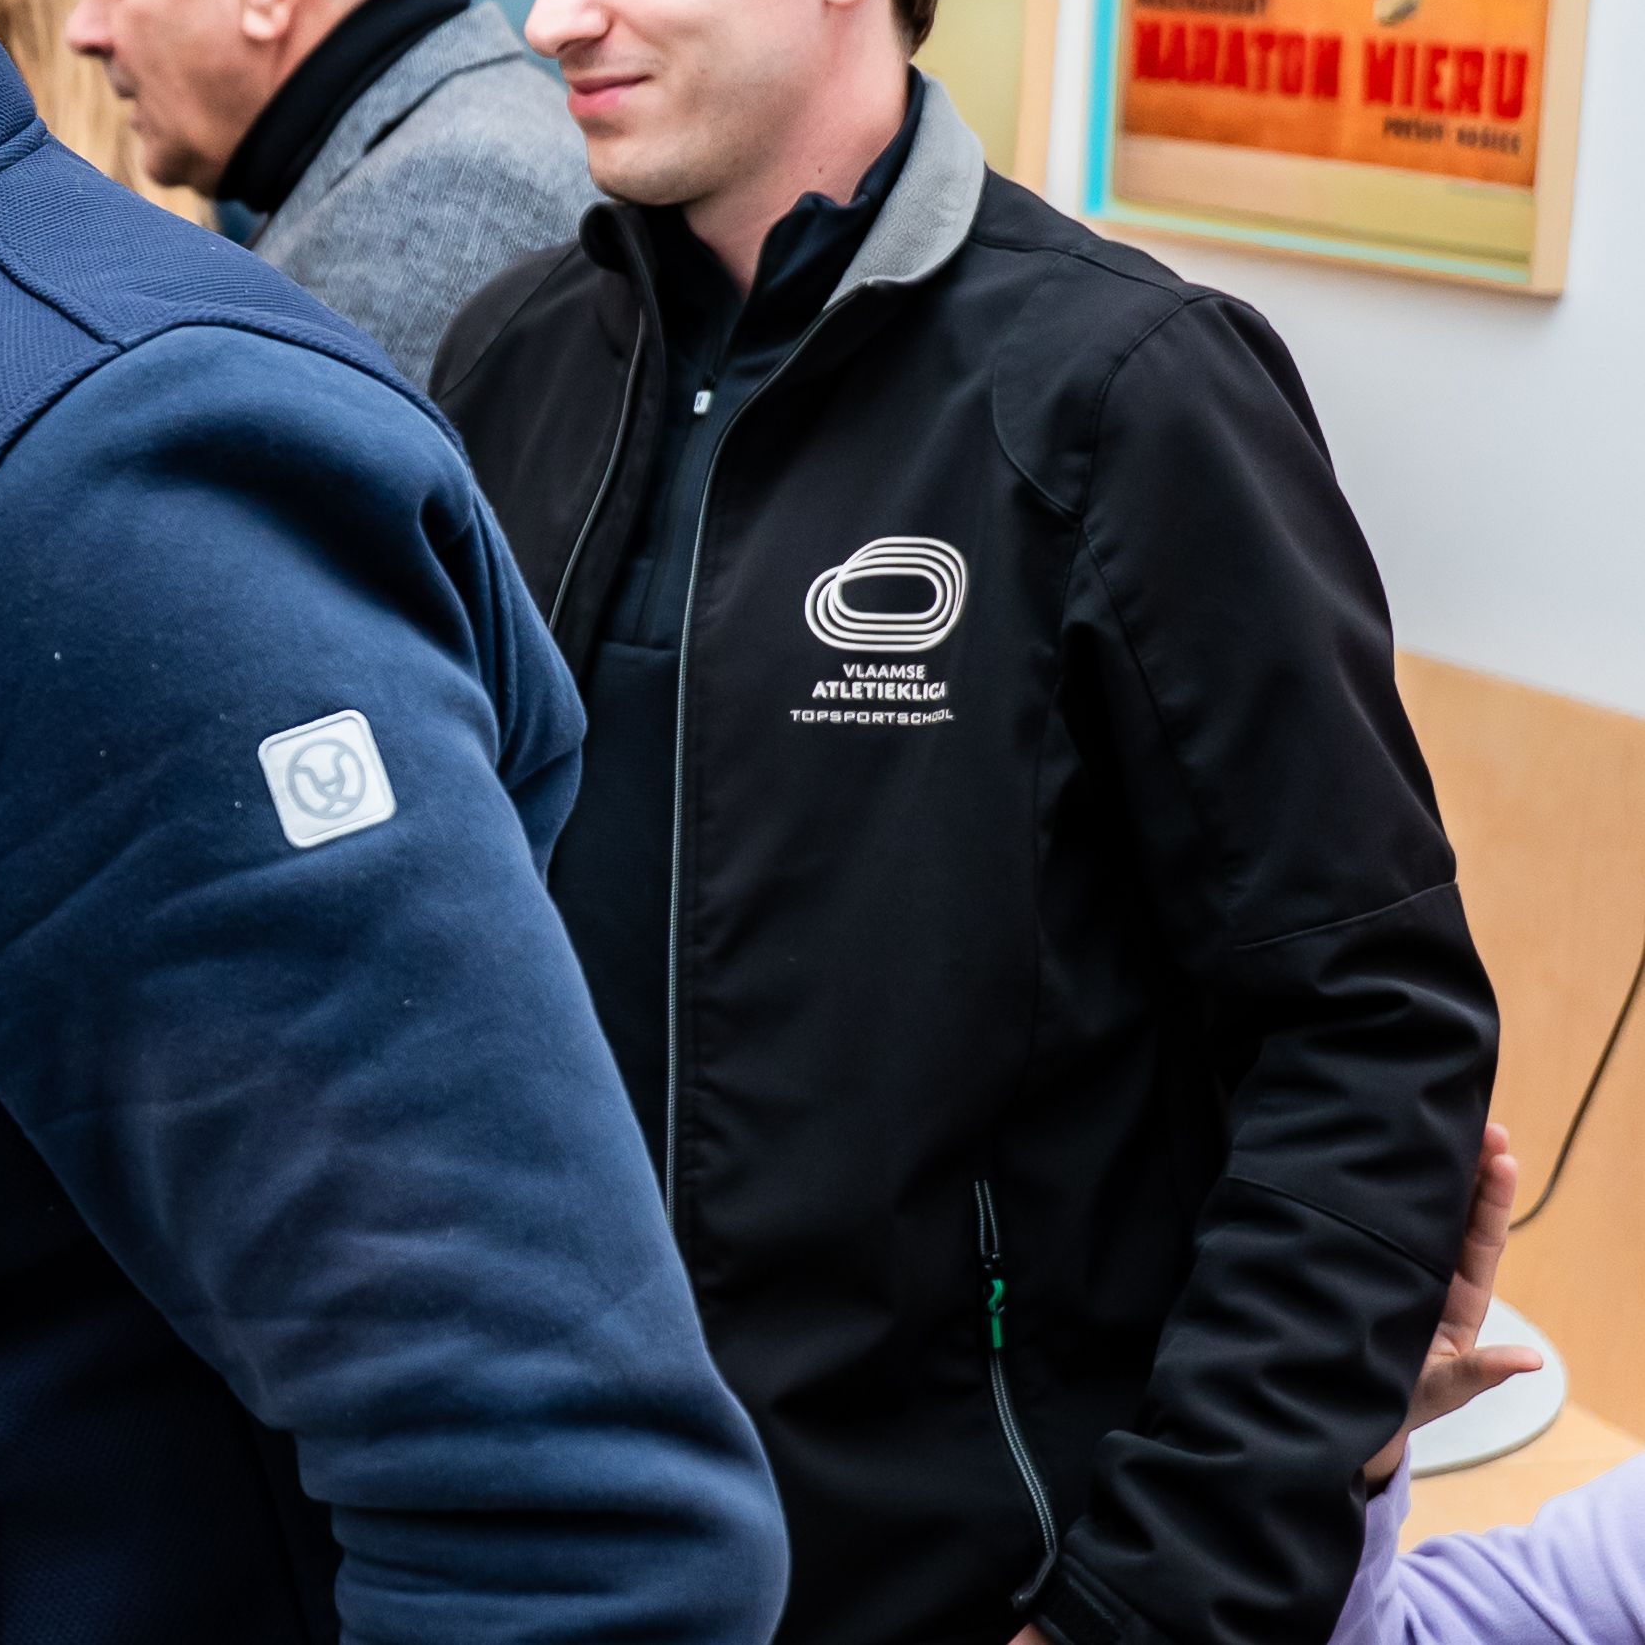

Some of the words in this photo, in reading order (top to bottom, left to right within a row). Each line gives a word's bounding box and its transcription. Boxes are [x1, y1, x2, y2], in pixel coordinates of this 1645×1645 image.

[1135, 19, 1343, 100] MARATON
[1363, 36, 1528, 121] MIERU
[842, 663, 927, 680] VLAAMSE
[811, 680, 948, 700] ATLETIEKLIGA
[789, 708, 955, 725] TOPSPORTSCHOOL
